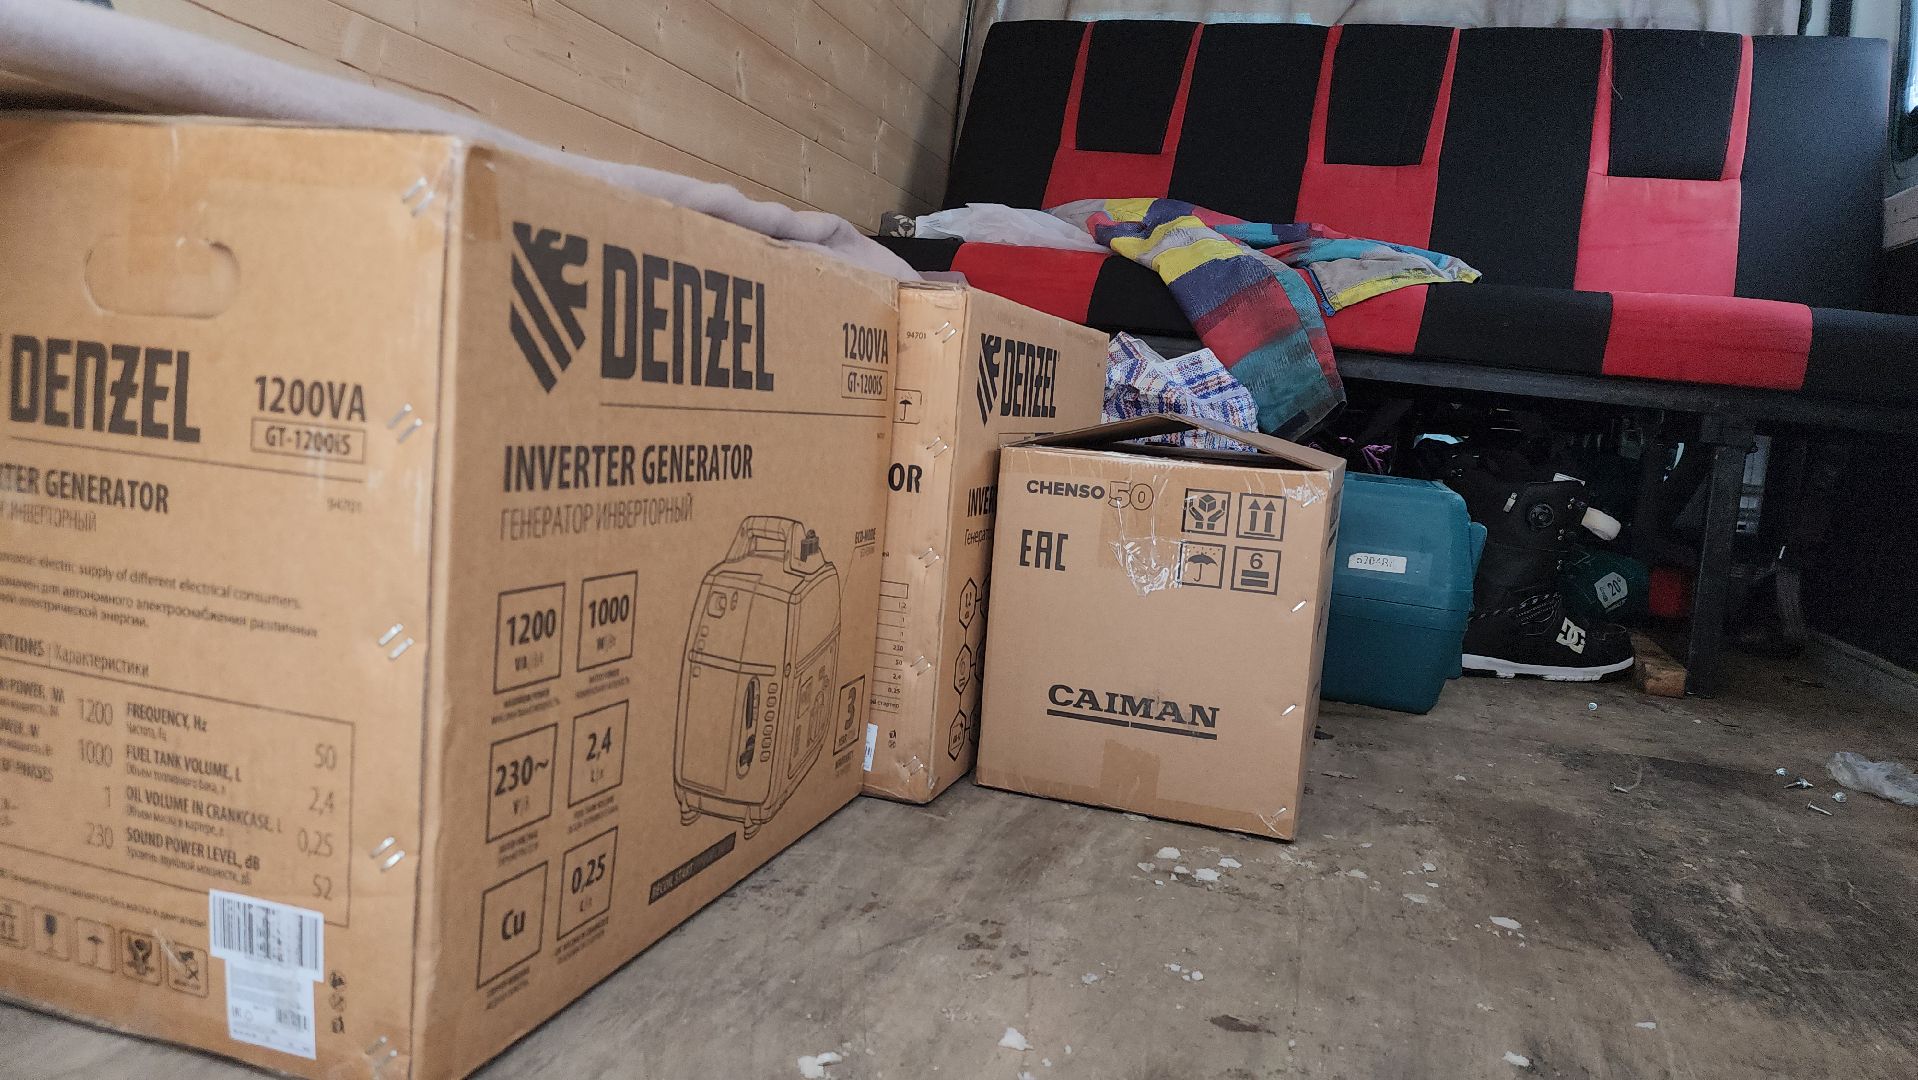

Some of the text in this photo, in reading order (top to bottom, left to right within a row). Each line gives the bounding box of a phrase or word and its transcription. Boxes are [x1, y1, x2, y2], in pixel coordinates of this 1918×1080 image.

[602, 243, 774, 392] DENZEL
[842, 322, 889, 364] 1200VA
[906, 331, 927, 340] 94701
[10, 333, 201, 443] DENZEL
[847, 371, 883, 396] GT-1200iS
[1000, 339, 1058, 419] DENZEL
[255, 375, 366, 422] 1200VA
[503, 443, 753, 493] INVERTER GENERATOR
[0, 462, 170, 515] TER GENERATOR
[1026, 479, 1105, 500] CHENSO
[500, 492, 694, 541] ГЕНЕРАТОР ИНВЕРТОРНЫЙ
[116, 567, 128, 581] of
[1250, 552, 1264, 570] 6
[506, 608, 557, 647] 1200
[588, 594, 630, 629] 1000
[78, 698, 114, 727] 1200
[1048, 684, 1220, 729] CAIMAN
[78, 738, 113, 769] 1000
[313, 743, 337, 771] 50
[585, 726, 612, 762] 2,4
[126, 743, 151, 765] FUEL
[154, 749, 182, 770] TANK
[183, 755, 233, 783] VOLUME,
[104, 784, 111, 808] 1
[144, 790, 189, 813] VOLUME
[192, 799, 204, 817] IN
[309, 786, 335, 815] 2,4
[85, 819, 114, 850] 230
[126, 826, 164, 848] SOUND
[165, 835, 204, 859] POWER
[297, 827, 333, 859] 0,25
[312, 873, 333, 901] 52
[571, 852, 607, 895] 0,25
[501, 909, 527, 941] Cu
